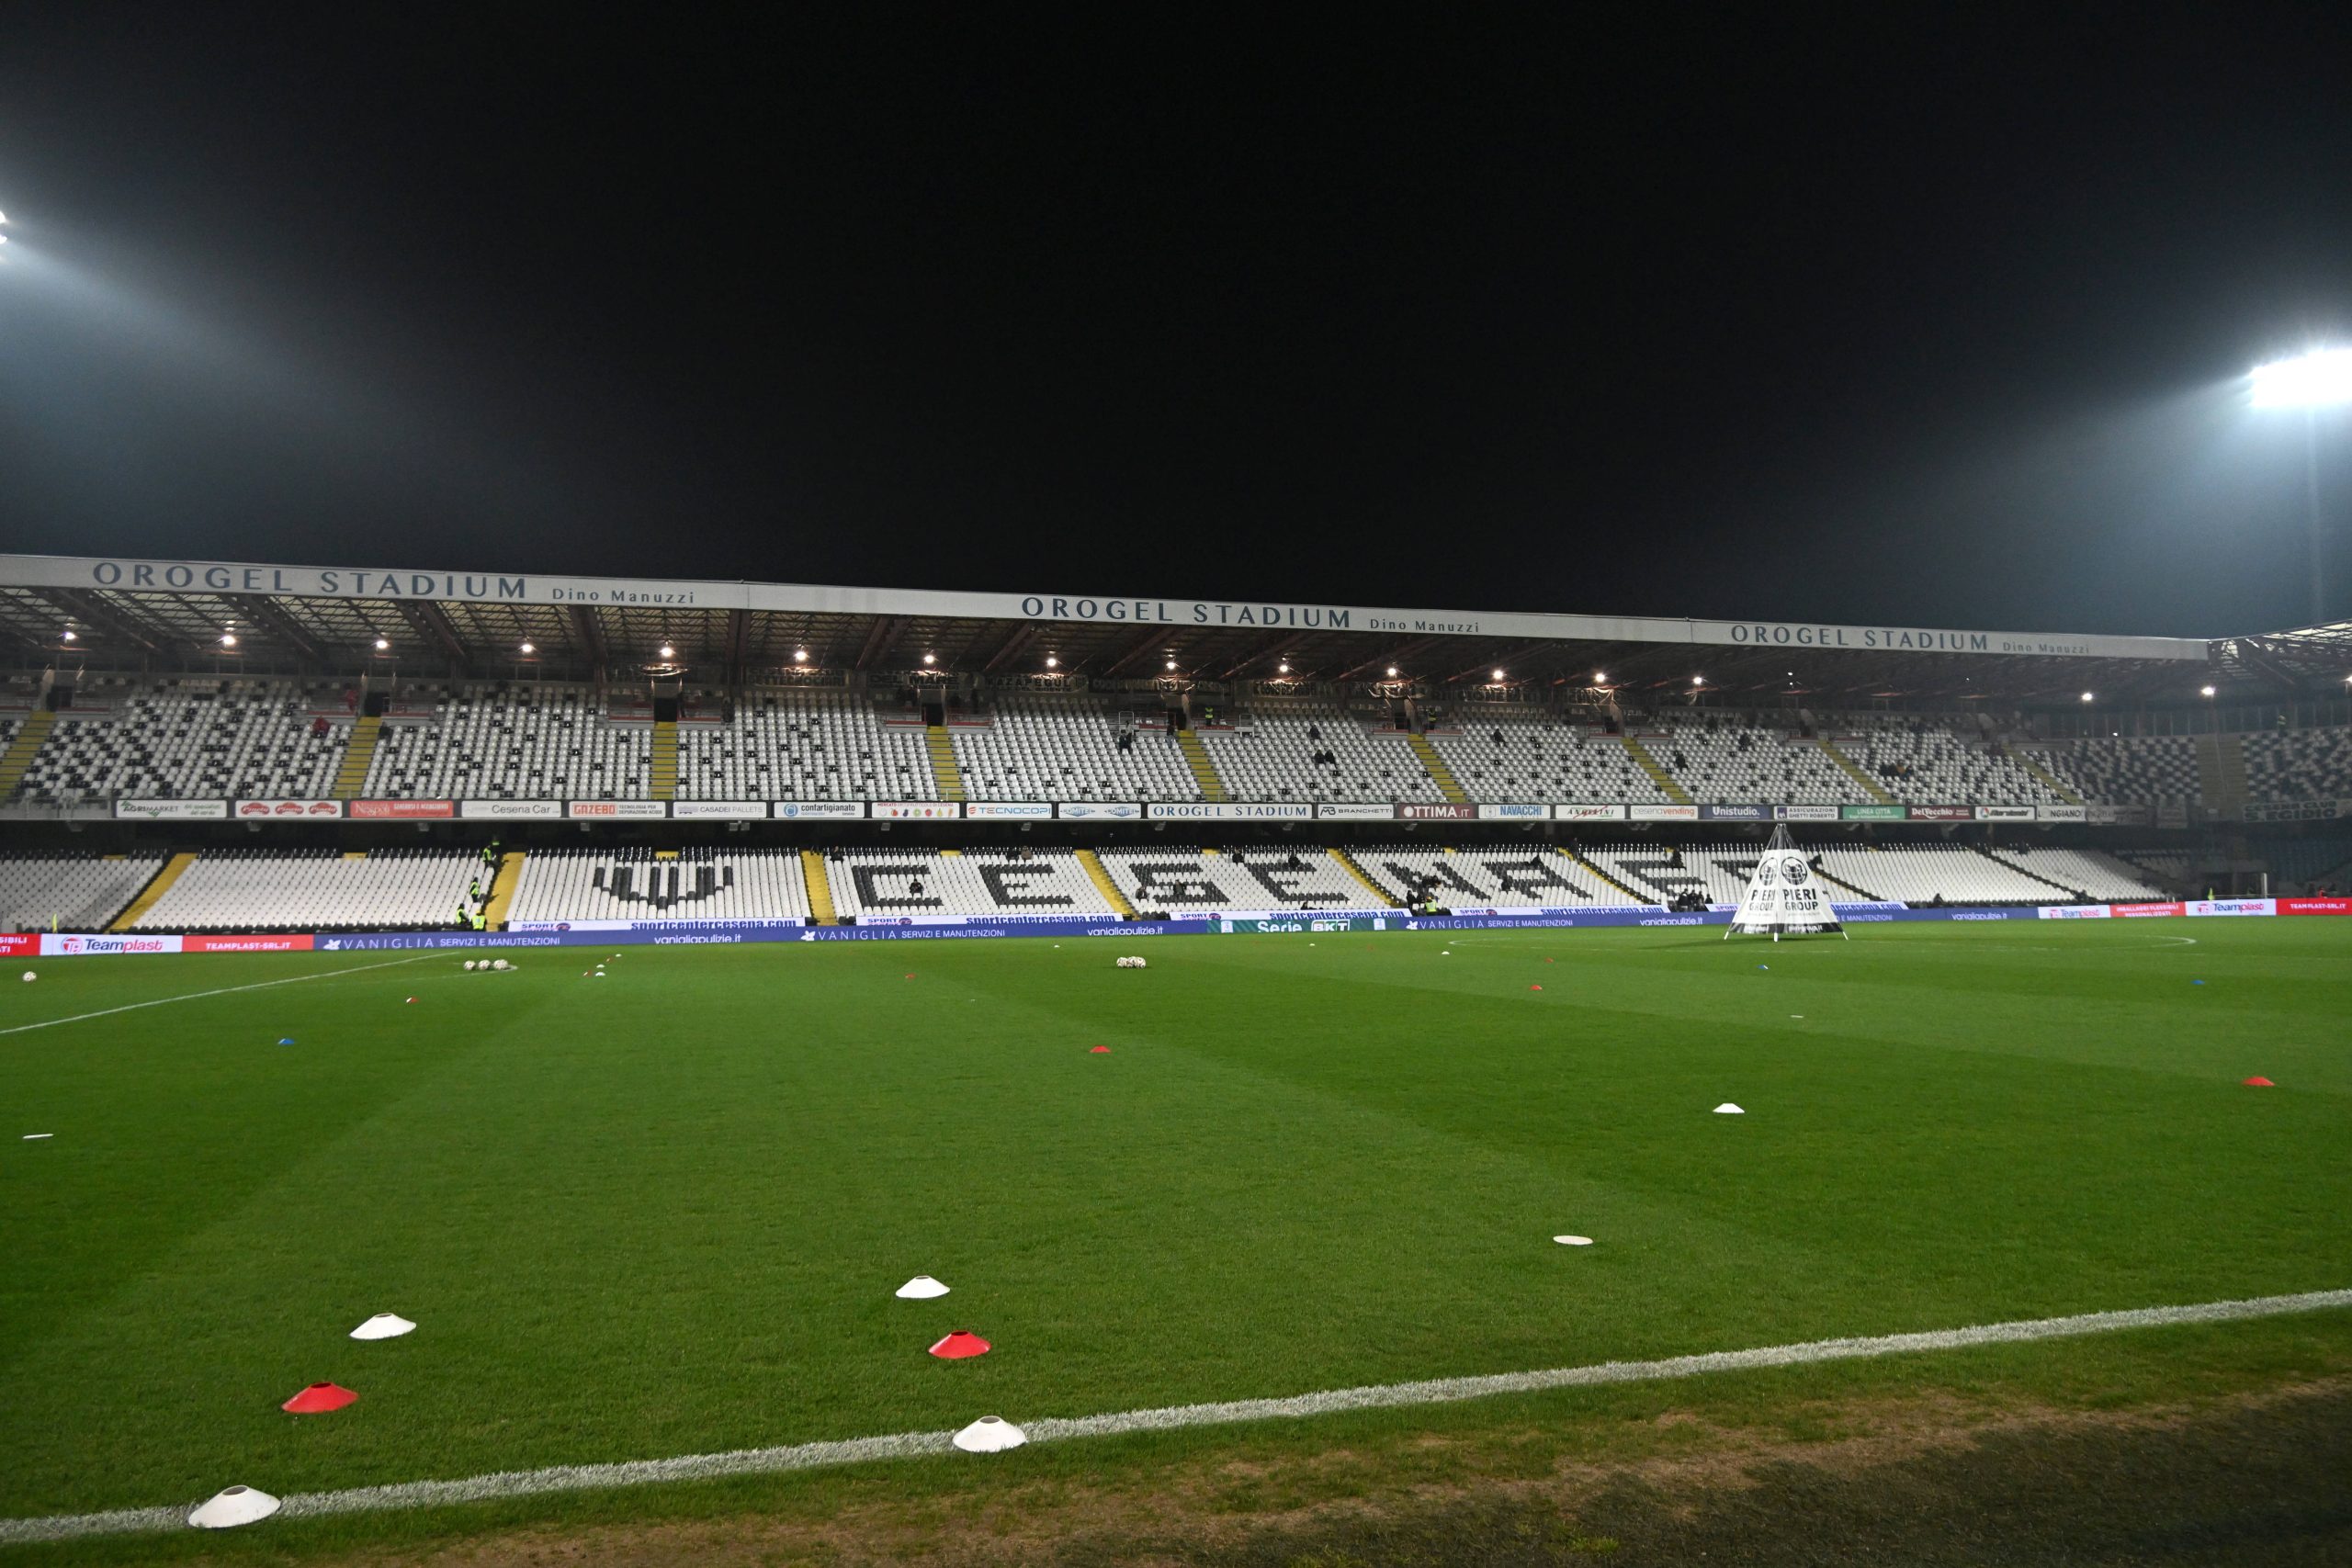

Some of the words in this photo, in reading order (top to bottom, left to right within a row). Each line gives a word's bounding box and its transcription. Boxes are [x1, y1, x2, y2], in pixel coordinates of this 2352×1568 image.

[93, 562, 292, 592] OROGEL
[321, 570, 525, 599] STADIUM
[552, 588, 599, 601] Dino
[611, 590, 695, 604] Manuzzi
[1022, 597, 1173, 622] OROGEL
[1193, 604, 1350, 628] STADIUM
[1370, 618, 1407, 630] Dino
[1415, 620, 1479, 633] Manuzzi
[1731, 625, 1849, 646] OROGEL
[1864, 630, 1987, 650] STADIUM
[2002, 642, 2032, 653] Dino
[2038, 643, 2090, 654] Manuzzi
[492, 805, 530, 814] Cesena
[533, 805, 550, 814] Car
[573, 805, 615, 815] GAZEBO
[1154, 807, 1225, 816] OROGEL
[1235, 807, 1306, 816] STADIUM
[1499, 806, 1542, 816] NAVACCHI
[1782, 888, 1816, 900] PIERI
[1784, 902, 1819, 911] GROUP
[2213, 902, 2265, 913] Teamplast
[1257, 920, 1303, 932] Serie
[1313, 922, 1349, 931] BKT
[1419, 920, 1485, 930] VANIGLIA
[818, 930, 897, 941] VANIGLIA
[901, 930, 933, 939] SERVIZI
[85, 939, 163, 953] Teamplast
[344, 937, 434, 950] VANIGLIA
[440, 938, 476, 946] SERVIZI
[480, 938, 485, 946] E
[488, 937, 560, 946] MANUTENZIONI
